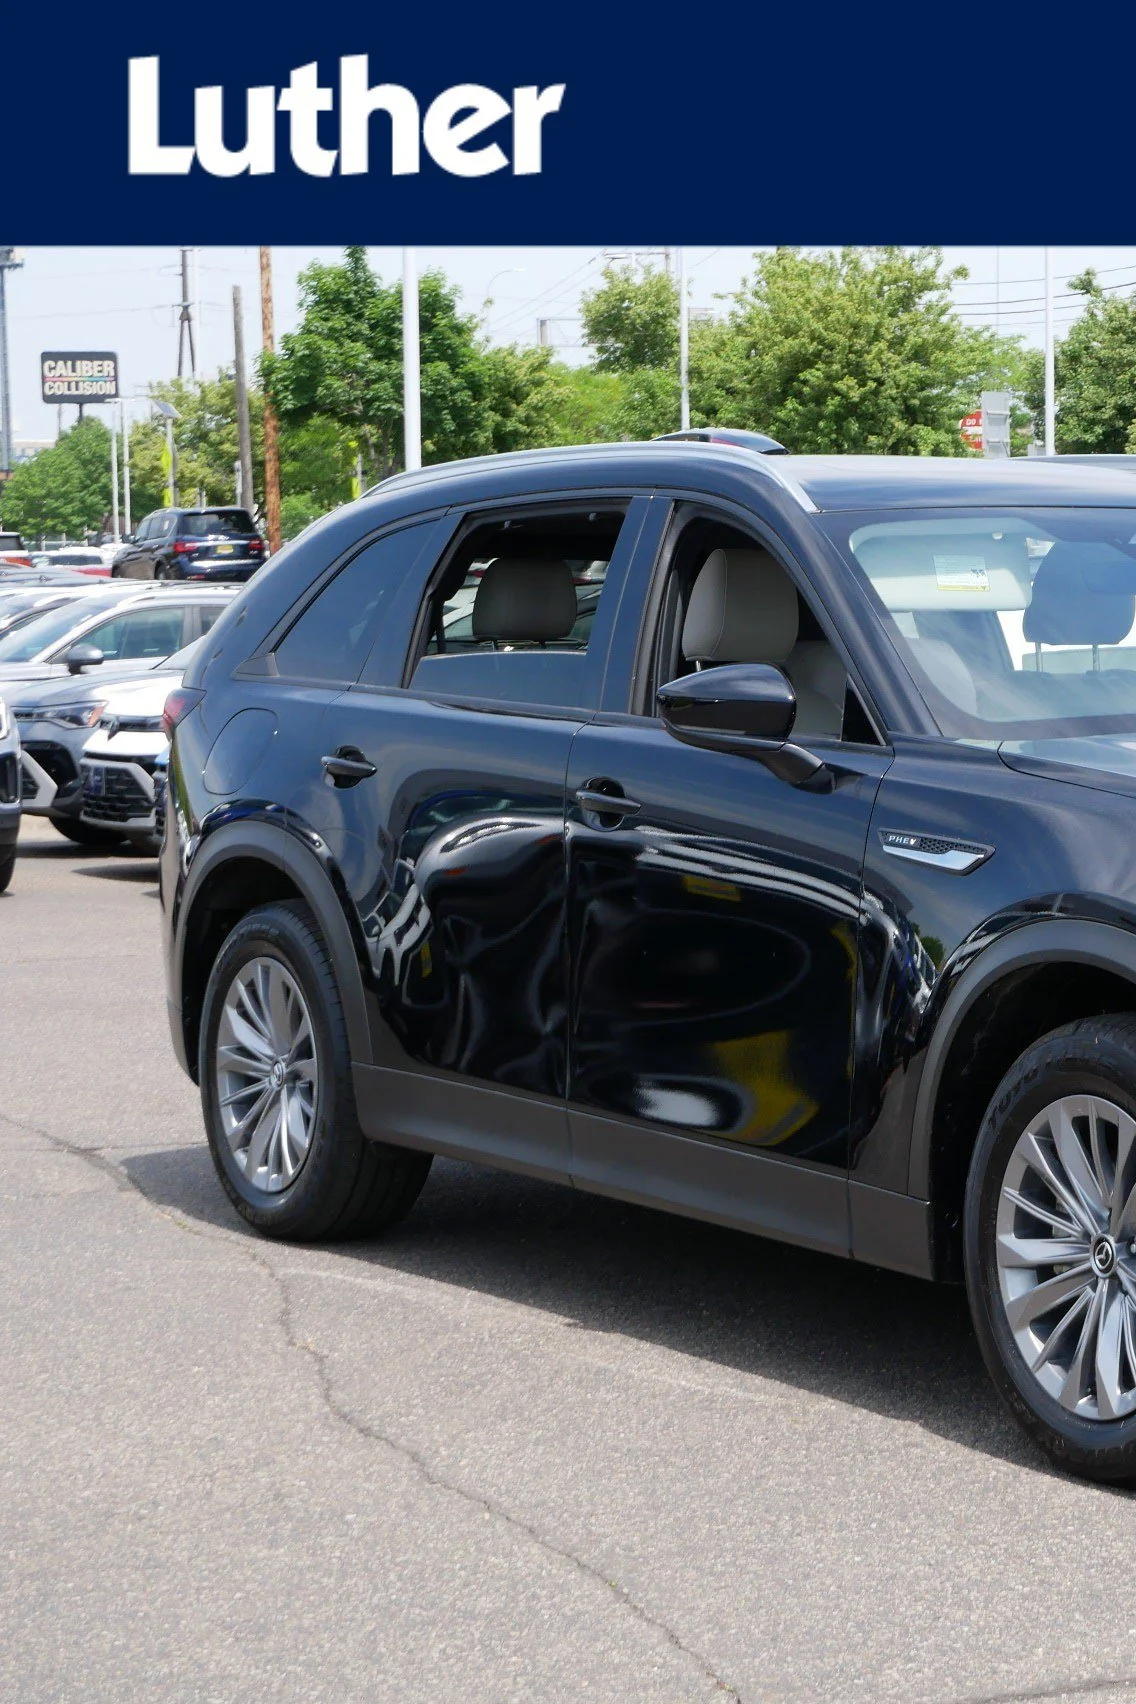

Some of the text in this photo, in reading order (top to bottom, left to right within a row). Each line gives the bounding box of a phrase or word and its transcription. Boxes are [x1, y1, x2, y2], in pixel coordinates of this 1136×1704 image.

[43, 360, 115, 377] CALIBER
[44, 381, 116, 396] COLLISION
[888, 835, 917, 846] PHEV
